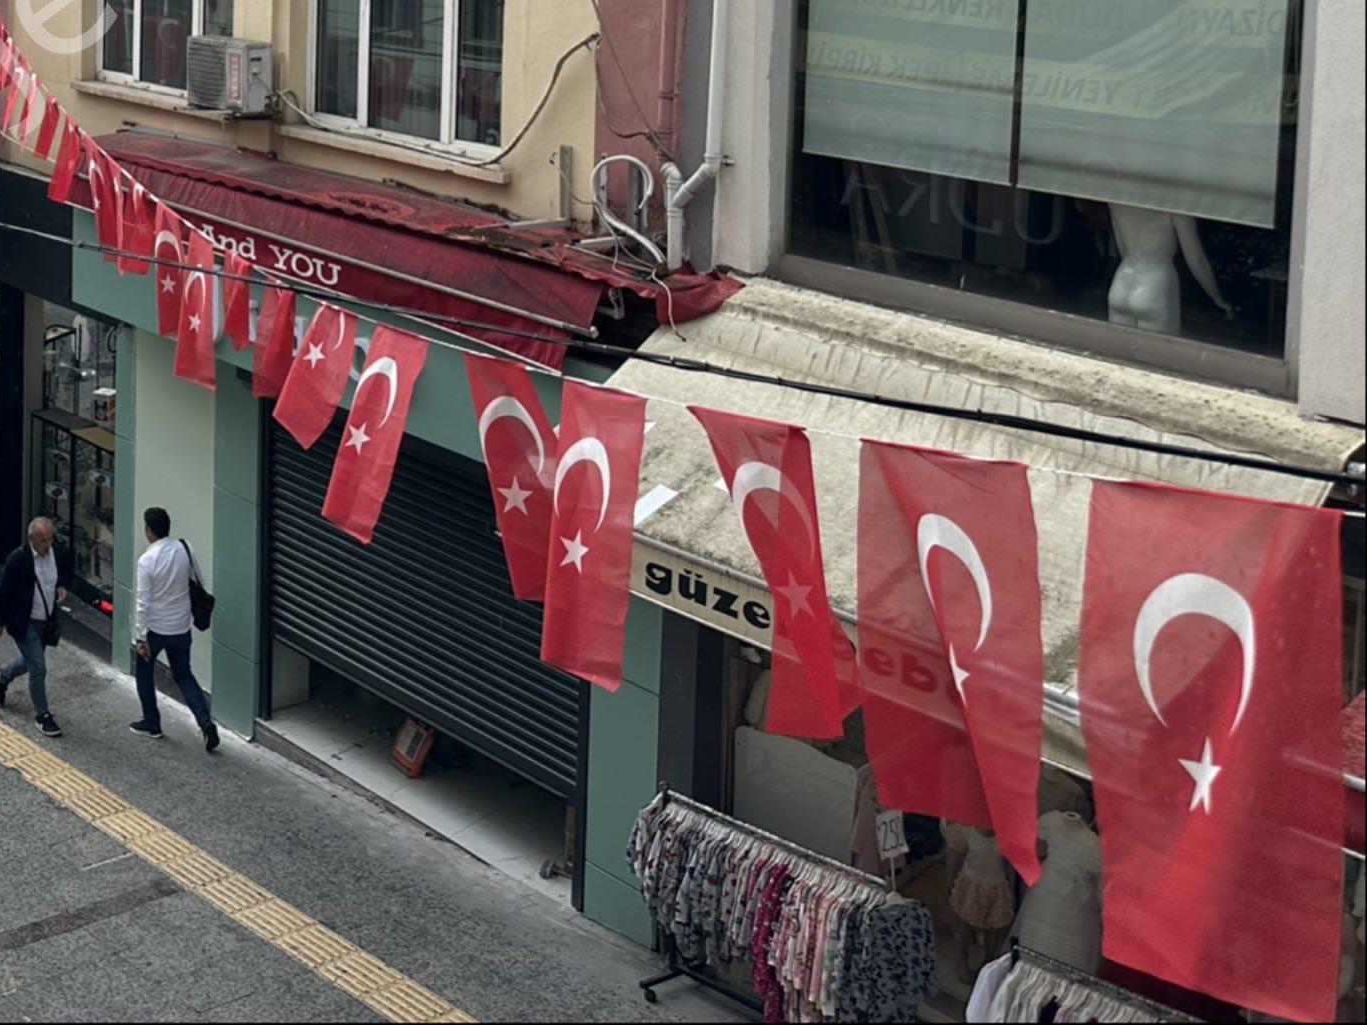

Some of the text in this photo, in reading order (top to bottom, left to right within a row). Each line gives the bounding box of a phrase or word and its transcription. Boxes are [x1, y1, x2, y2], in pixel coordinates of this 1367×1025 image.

[201, 223, 342, 286] And YOU
[644, 561, 773, 631] güze
